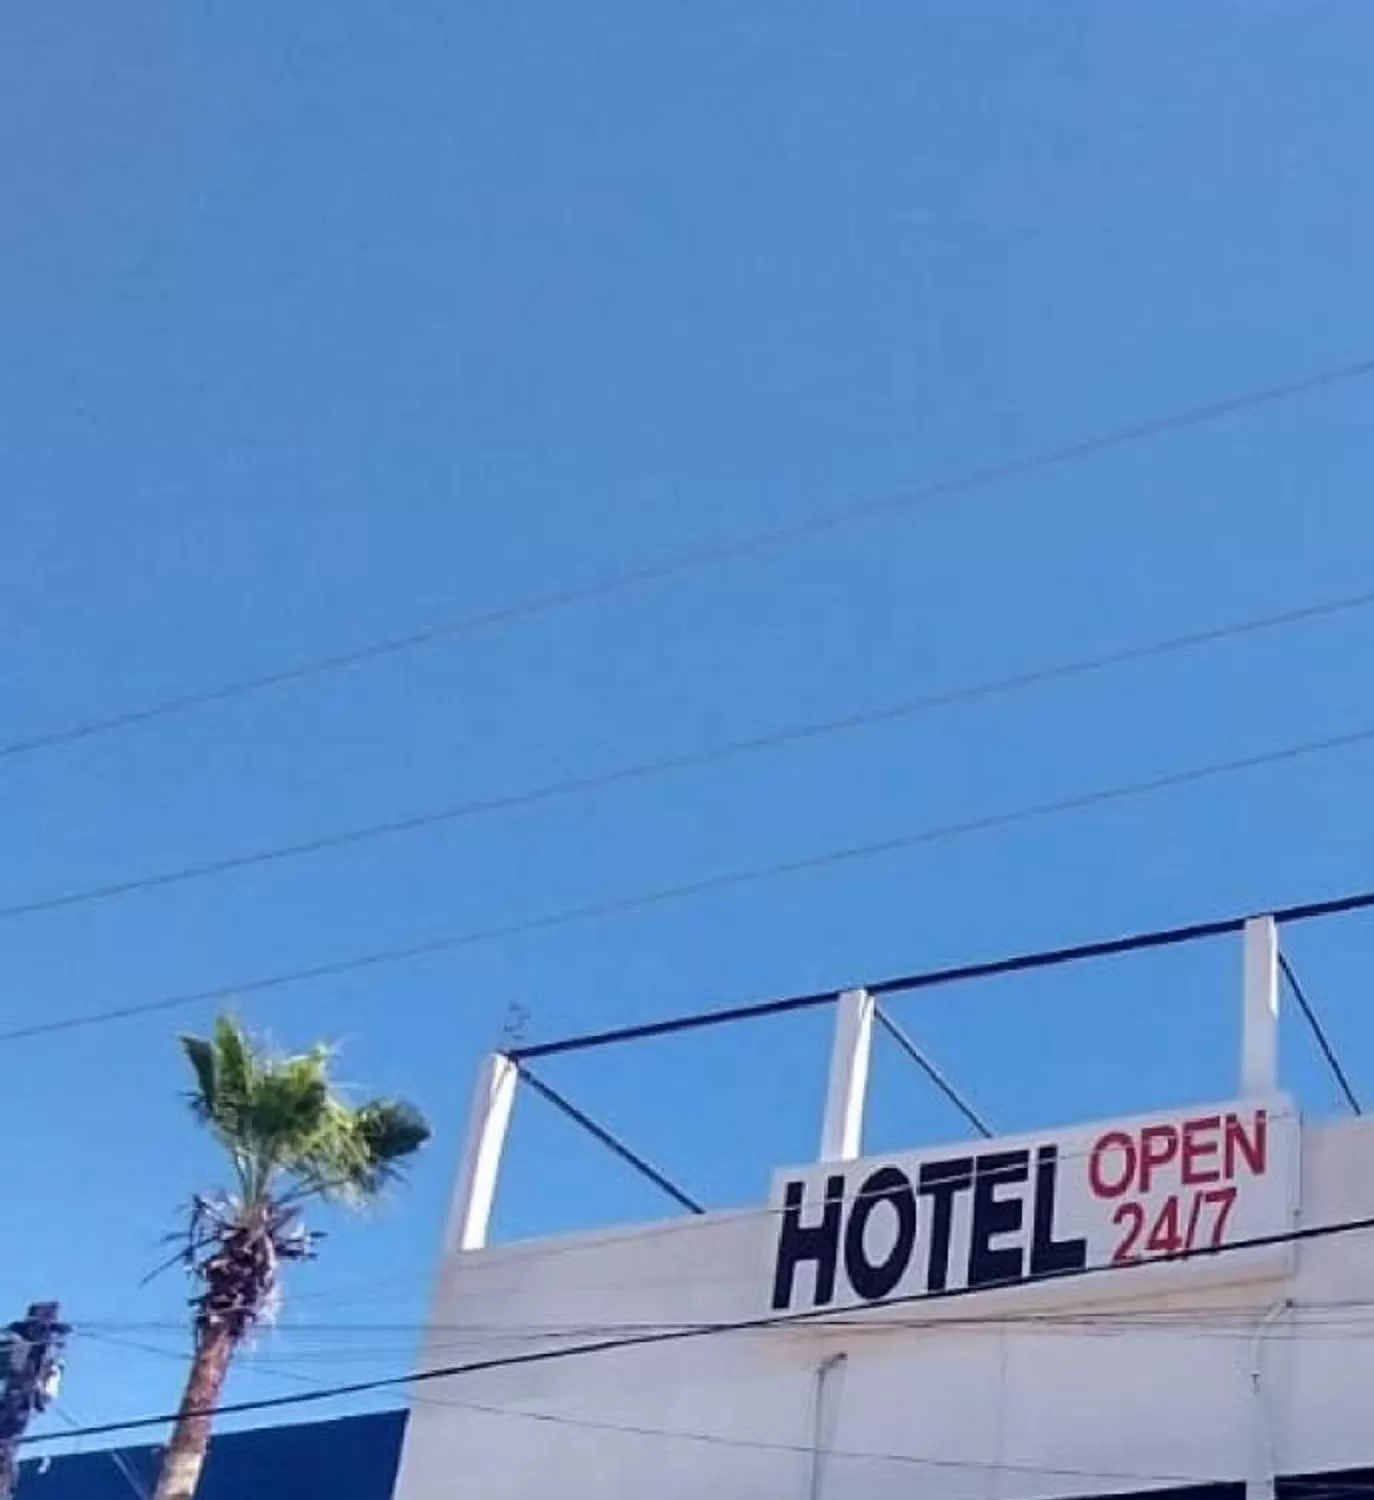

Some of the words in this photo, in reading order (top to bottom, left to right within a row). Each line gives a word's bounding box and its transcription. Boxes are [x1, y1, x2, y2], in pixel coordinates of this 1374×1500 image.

[1087, 1109, 1267, 1198] OPEN
[772, 1144, 1088, 1311] HOTEL
[1111, 1187, 1238, 1266] 24/7
